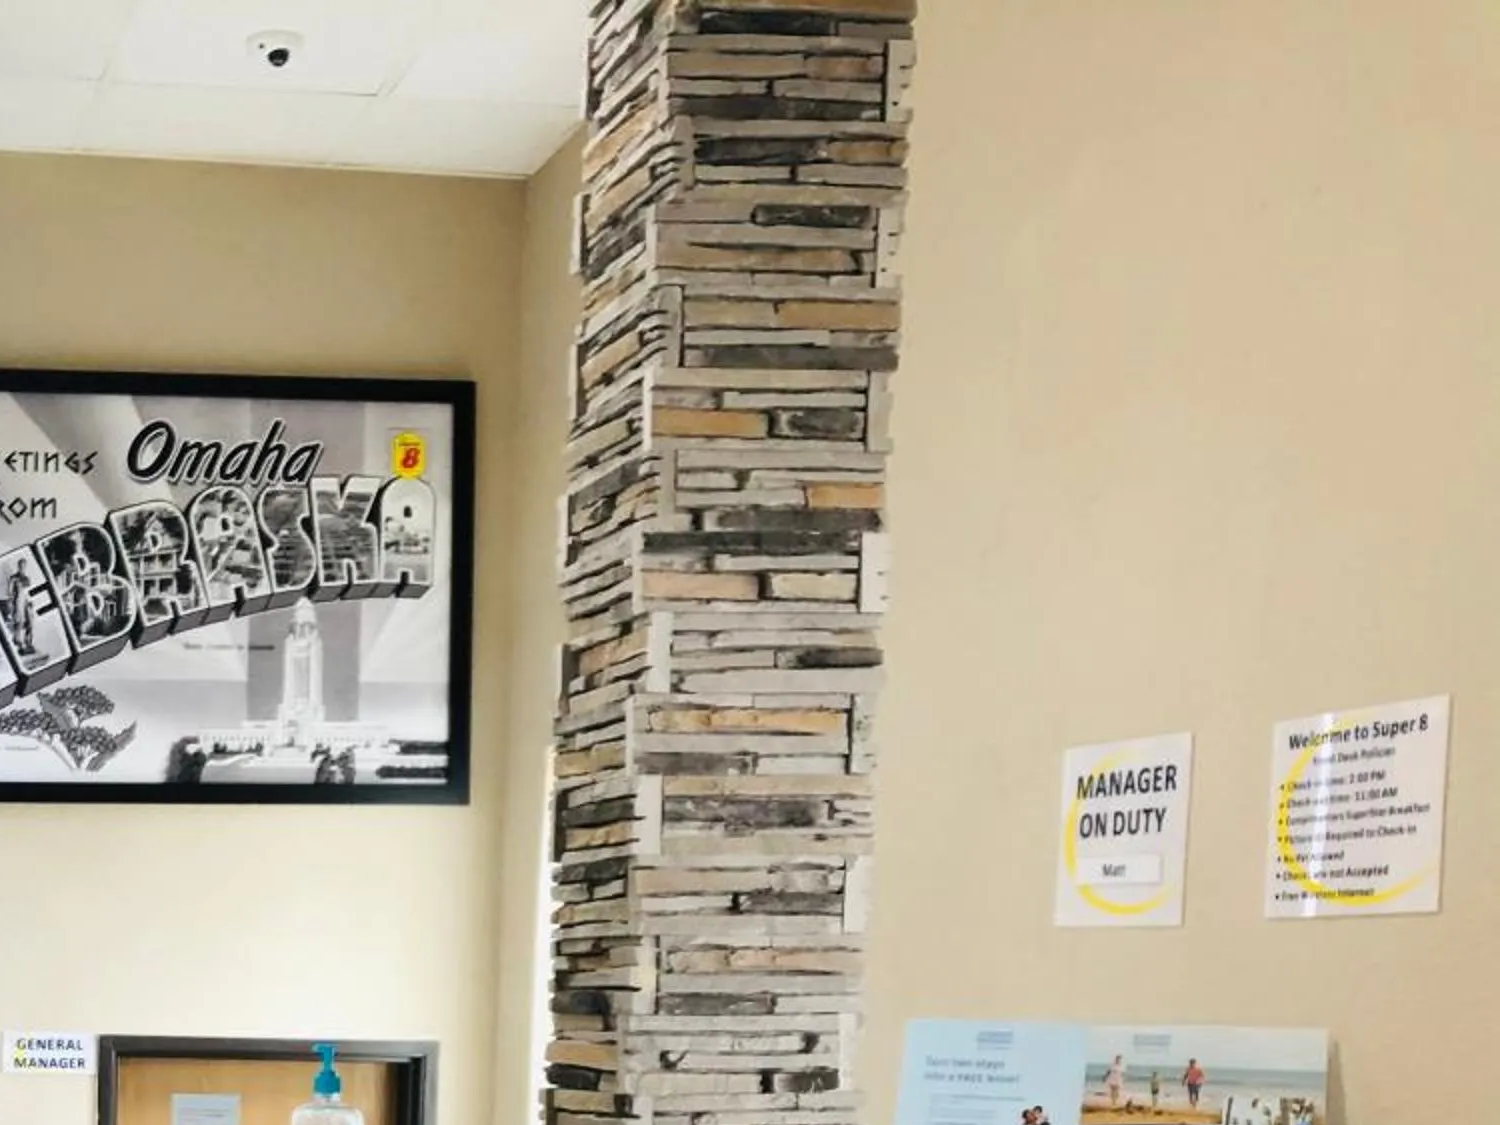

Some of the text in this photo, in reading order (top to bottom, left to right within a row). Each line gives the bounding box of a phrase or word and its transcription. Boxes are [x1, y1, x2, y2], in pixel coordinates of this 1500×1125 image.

[127, 419, 323, 484] Omaha
[1354, 725, 1369, 741] to
[1372, 719, 1417, 739] Super
[1419, 712, 1429, 732] 8
[1076, 764, 1177, 800] MANAGER
[1079, 806, 1167, 839] ON DUTY
[1345, 864, 1390, 878] Accepted
[16, 1039, 84, 1052] GENERAL
[13, 1057, 86, 1070] MANAGER
